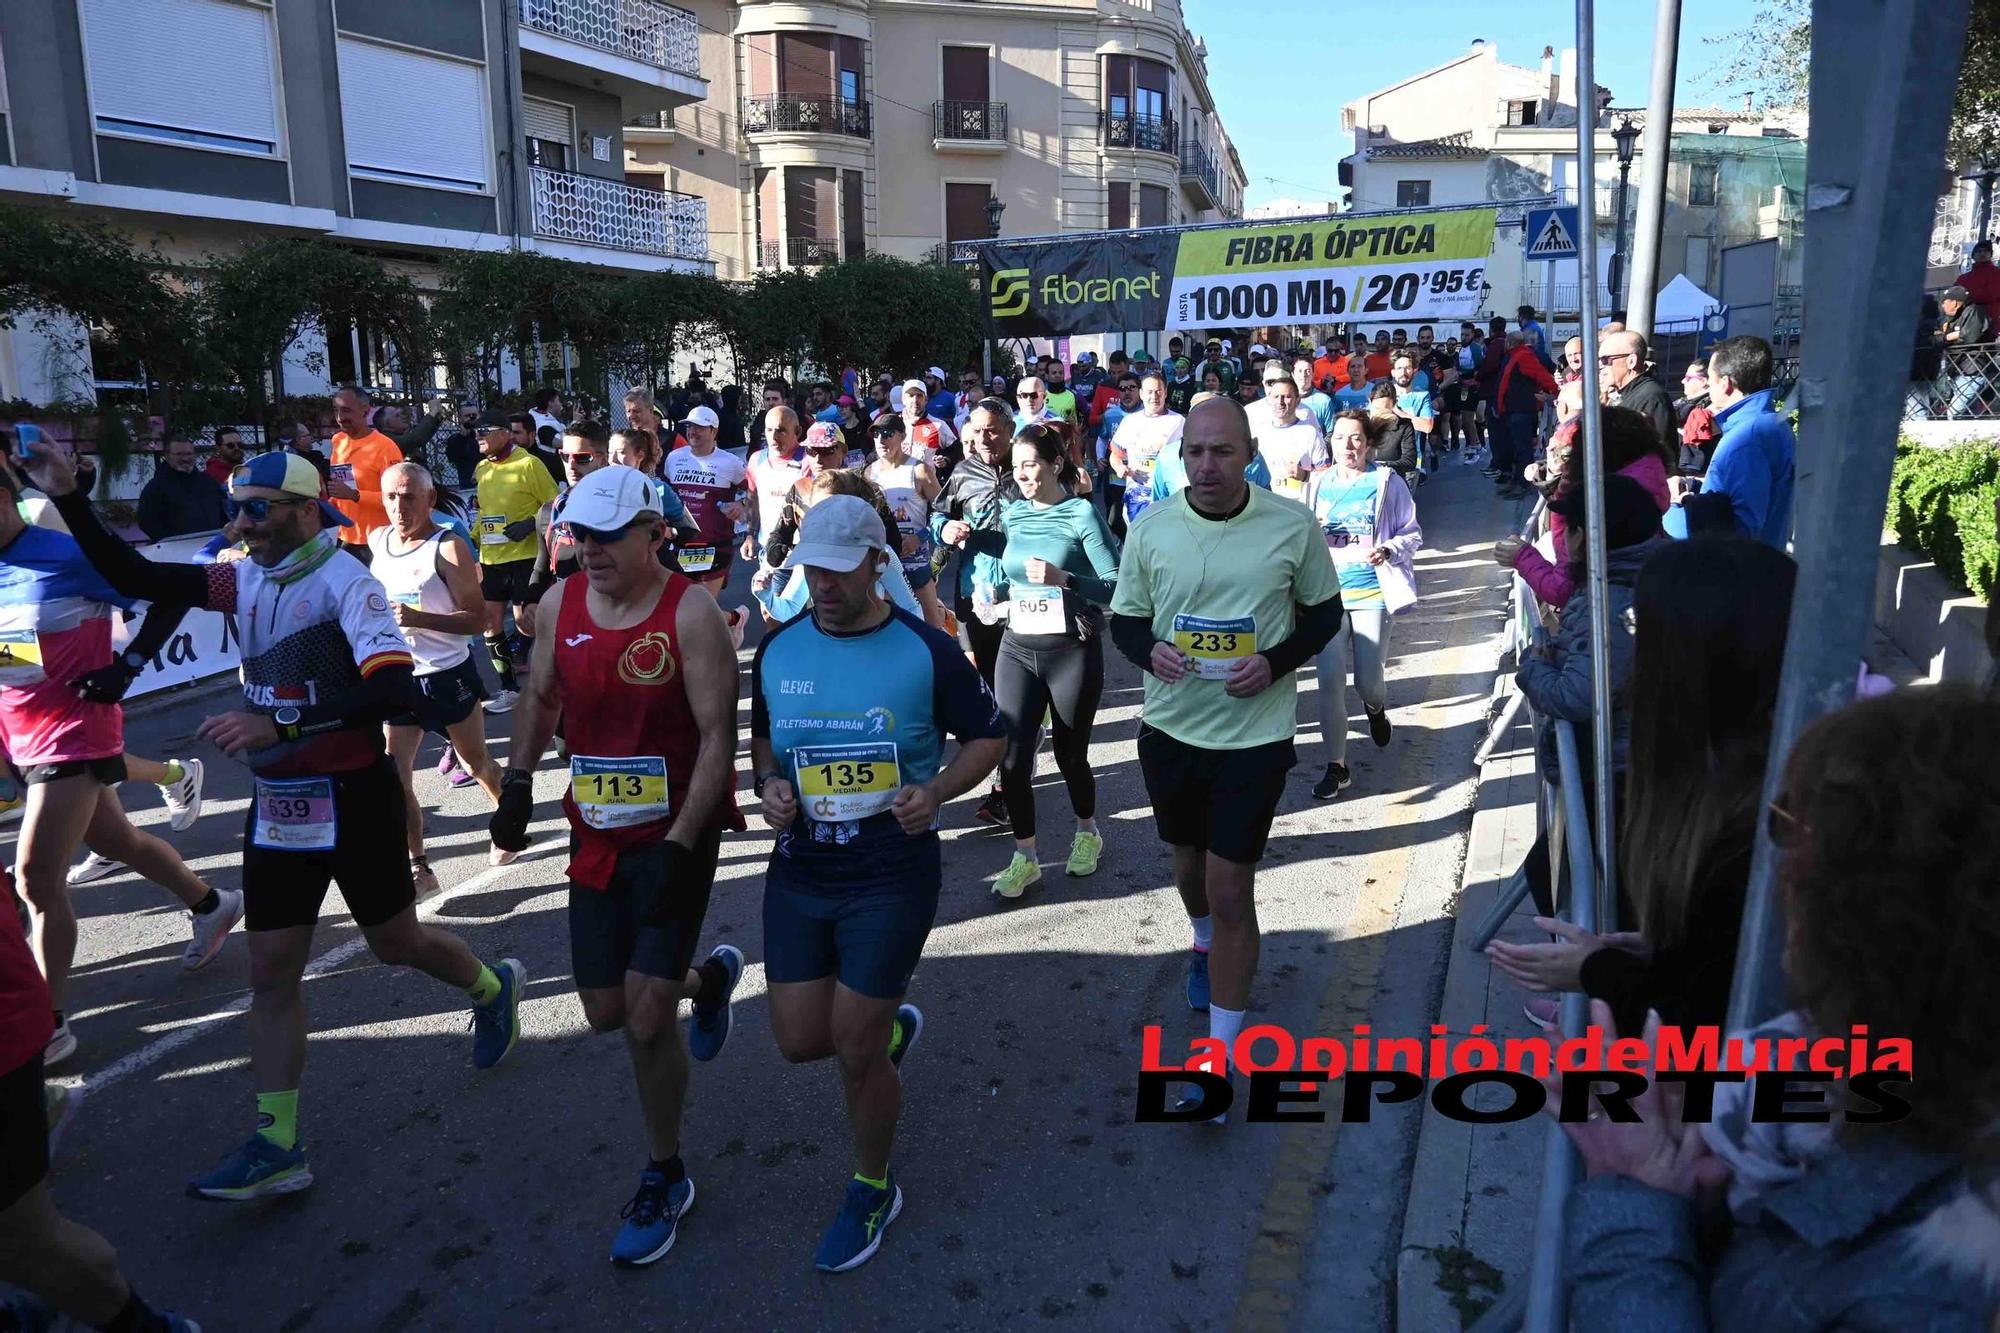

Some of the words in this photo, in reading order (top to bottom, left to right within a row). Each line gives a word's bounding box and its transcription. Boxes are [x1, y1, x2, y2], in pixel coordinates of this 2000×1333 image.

[1225, 233, 1313, 266] FIBRA
[1324, 223, 1435, 260] ÓPTICA
[1040, 271, 1161, 305] fibranet
[1179, 293, 1188, 322] HASTA
[1190, 283, 1278, 321] 1000
[1287, 279, 1346, 316] Mb
[484, 523, 495, 532] 19
[1332, 534, 1360, 546] 714
[1190, 632, 1237, 652] 233
[776, 719, 823, 729] ATLETISMO
[820, 763, 874, 786] 135
[593, 775, 643, 797] 113
[269, 799, 311, 818] 639
